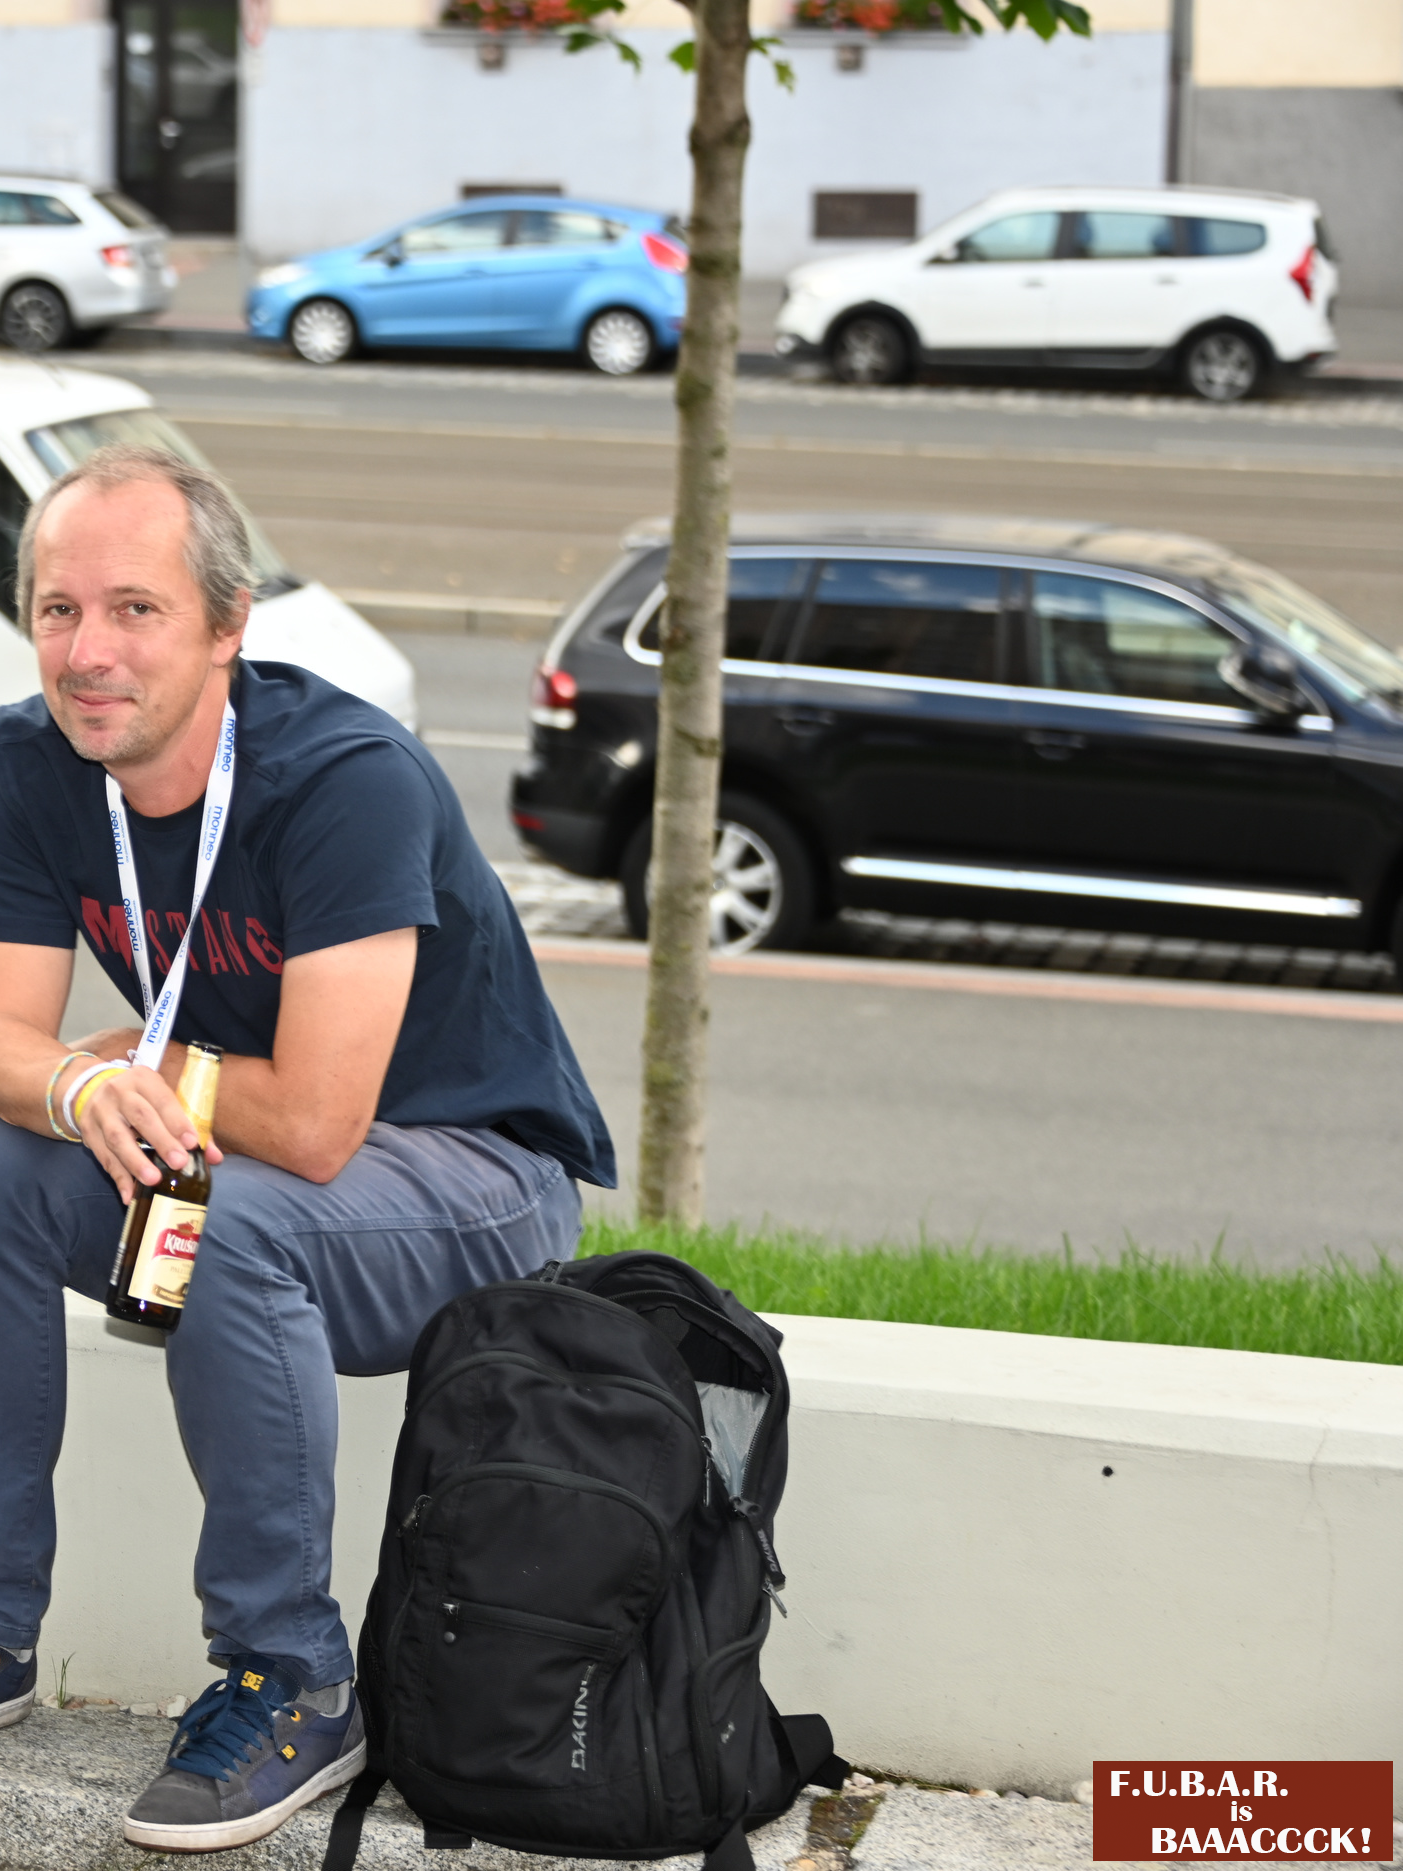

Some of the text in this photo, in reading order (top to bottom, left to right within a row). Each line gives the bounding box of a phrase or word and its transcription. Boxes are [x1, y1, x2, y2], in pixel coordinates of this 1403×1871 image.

[221, 718, 236, 772] monneo
[110, 810, 125, 865] monneo
[204, 805, 224, 861] monneo
[81, 896, 283, 976] MSTANG
[123, 898, 139, 952] monneo
[146, 990, 172, 1044] monneo
